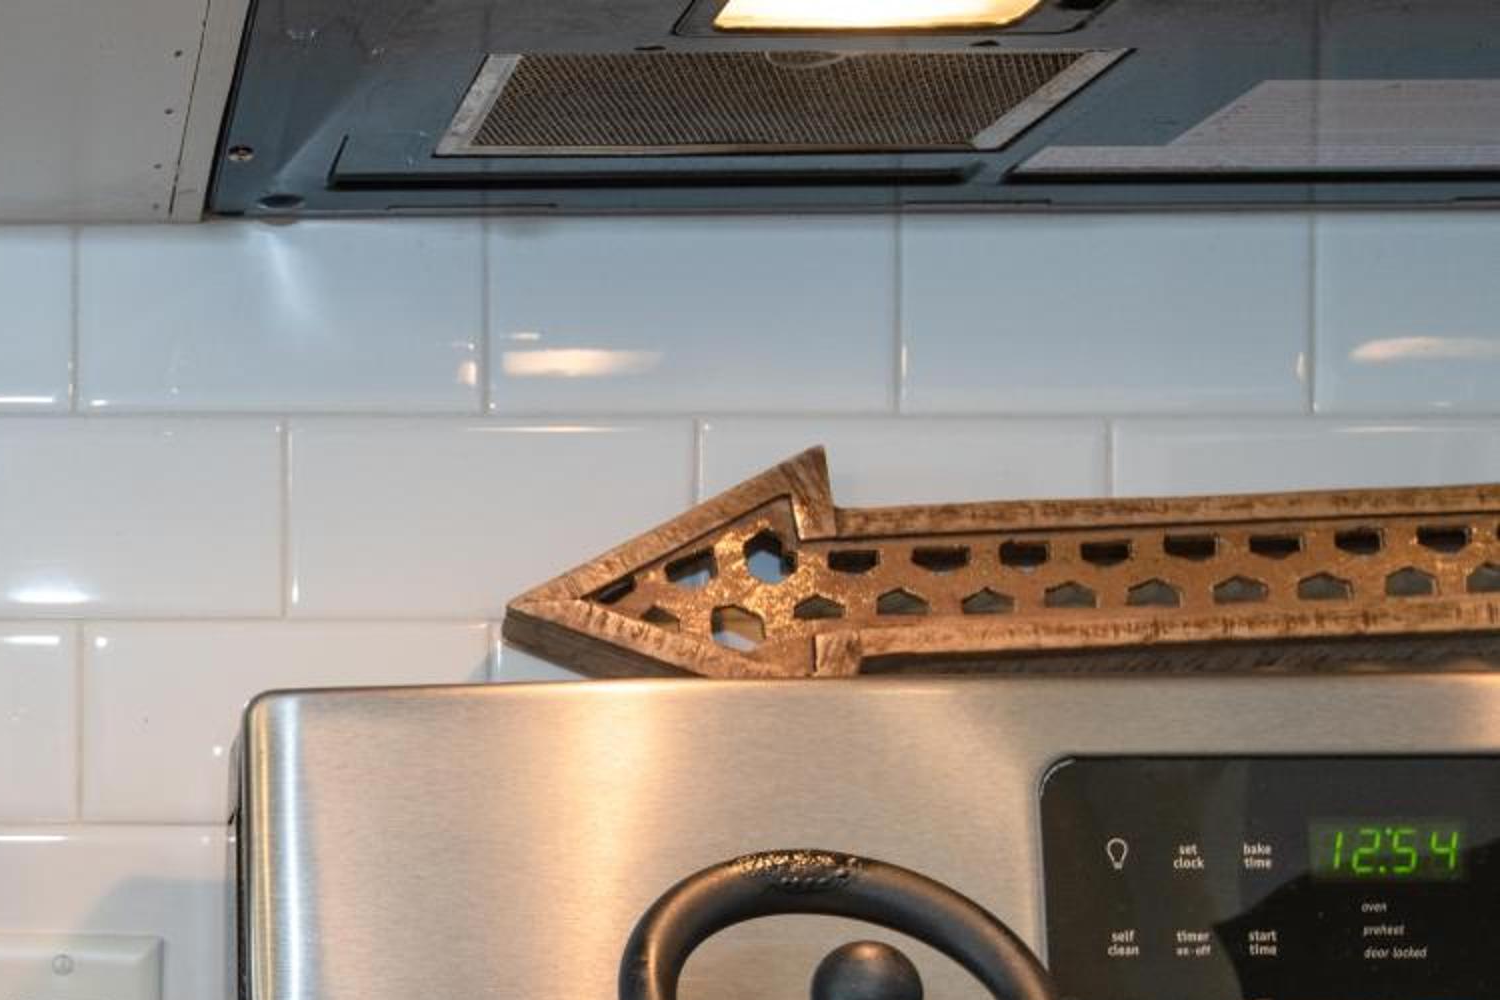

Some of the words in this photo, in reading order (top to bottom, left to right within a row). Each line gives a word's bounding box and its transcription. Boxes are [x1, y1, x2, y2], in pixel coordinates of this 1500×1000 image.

[1179, 843, 1197, 856] set
[1243, 842, 1272, 856] bake
[1332, 827, 1459, 875] 12:54
[1173, 856, 1205, 870] clock
[1244, 856, 1273, 870] time
[1360, 902, 1388, 913] oven
[1111, 929, 1136, 943] self
[1175, 929, 1211, 943] timer
[1248, 929, 1278, 943] start
[1363, 924, 1406, 938] preheat
[1106, 943, 1141, 957] clean
[1249, 943, 1278, 957] time
[1362, 946, 1390, 960] door
[1392, 945, 1429, 960] locked
